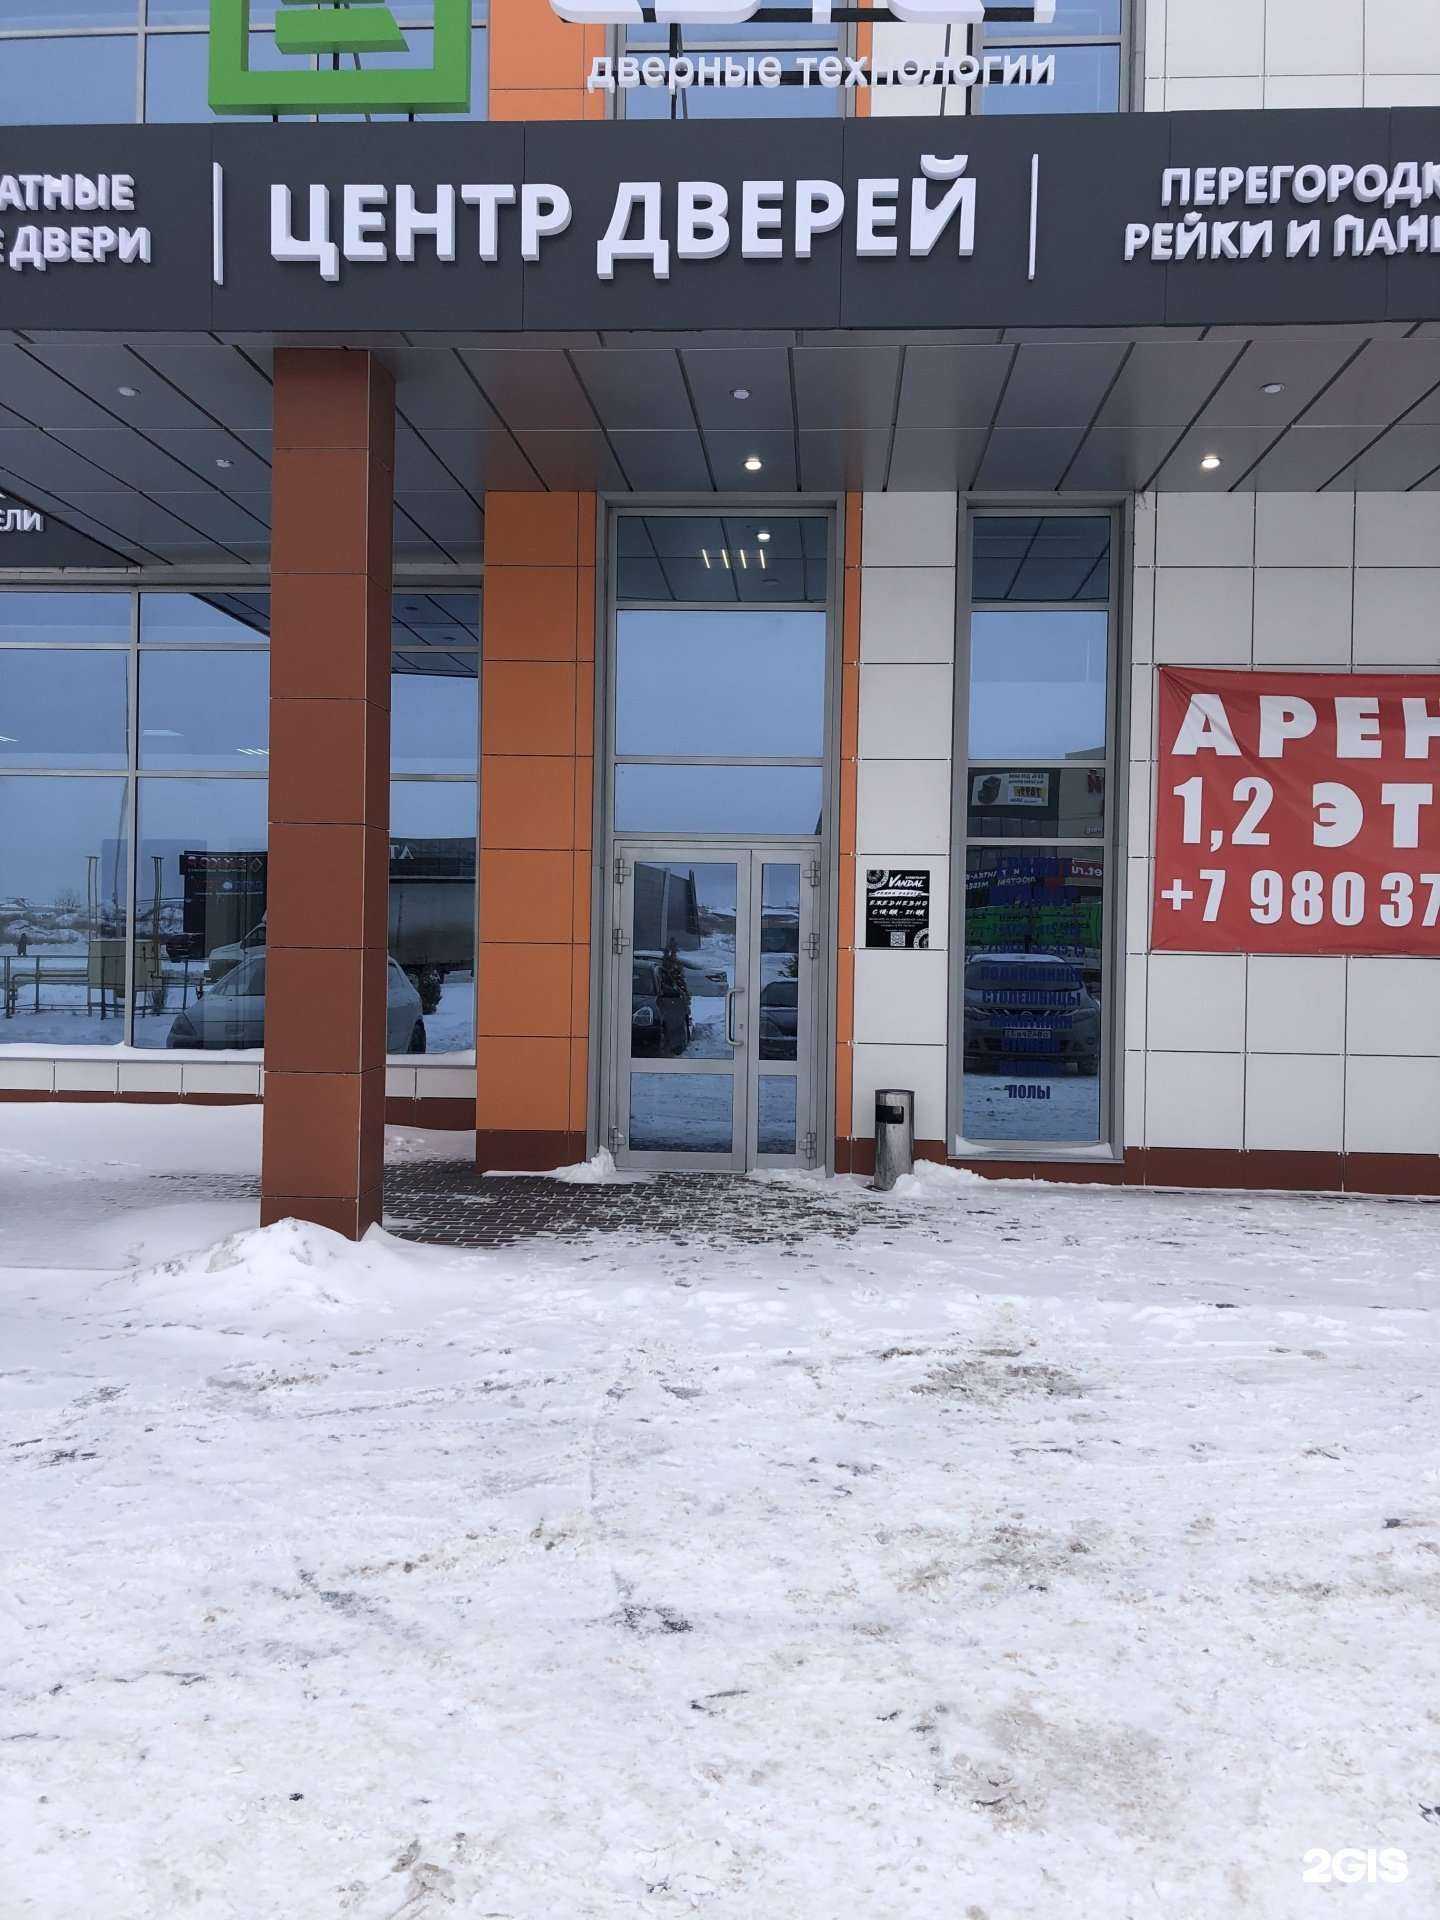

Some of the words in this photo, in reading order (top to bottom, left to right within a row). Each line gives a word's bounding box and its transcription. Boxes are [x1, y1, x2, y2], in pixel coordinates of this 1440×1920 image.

[587, 55, 782, 95] дверные
[797, 54, 1056, 88] технологии
[0, 174, 135, 211] АТНЫЕ
[271, 183, 572, 281] ЦЕНТР
[596, 154, 977, 279] ДВЕРЕЙ
[1124, 211, 1273, 260] РЕЙКИ
[1286, 219, 1321, 258] И
[10, 225, 151, 271] ДВЕРИ
[1171, 694, 1440, 759] АРЕН
[1173, 776, 1274, 852] 1,2
[1313, 782, 1433, 848] ЭТ
[1161, 870, 1226, 922] +7
[1250, 869, 1365, 926] 980
[1380, 872, 1440, 927] 37
[1008, 1085, 1051, 1100] ПОЛЫ
